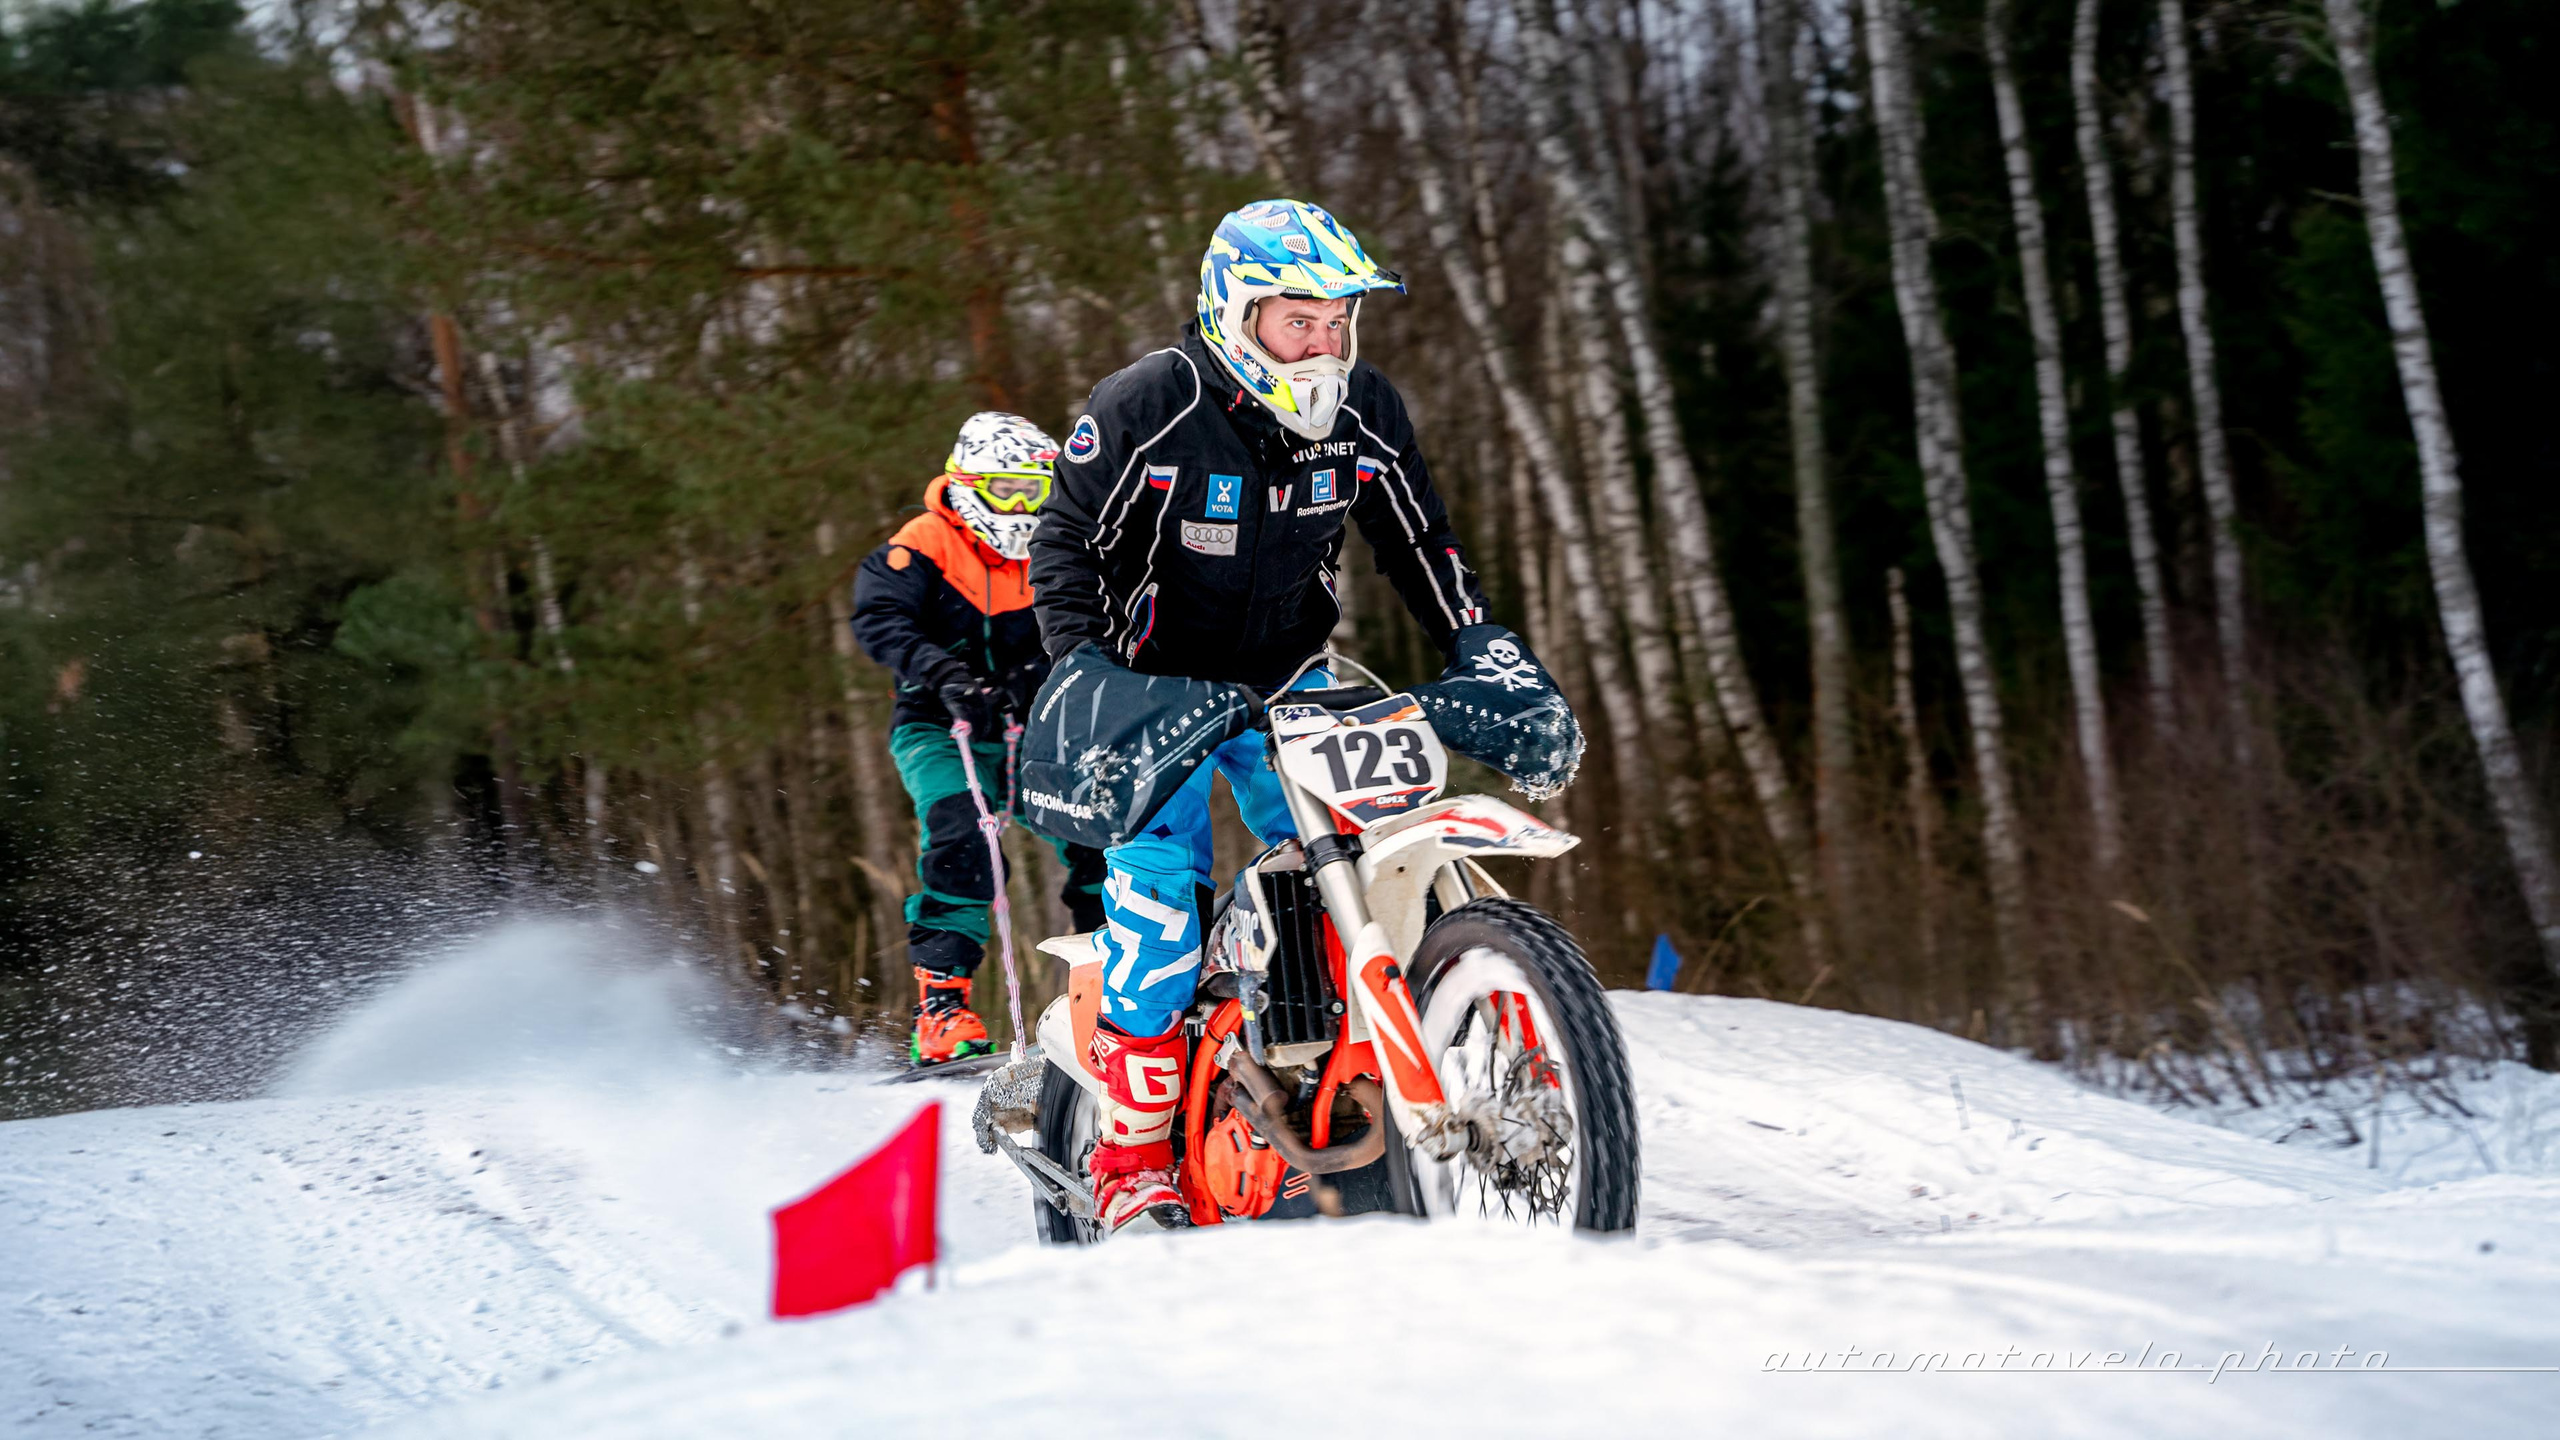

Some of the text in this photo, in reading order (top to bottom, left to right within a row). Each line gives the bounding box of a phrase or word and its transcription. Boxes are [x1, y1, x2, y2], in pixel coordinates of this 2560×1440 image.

[1211, 504, 1233, 513] YOTA
[1185, 541, 1206, 551] Audi
[1311, 728, 1431, 793] 123
[1125, 1053, 1180, 1103] G
